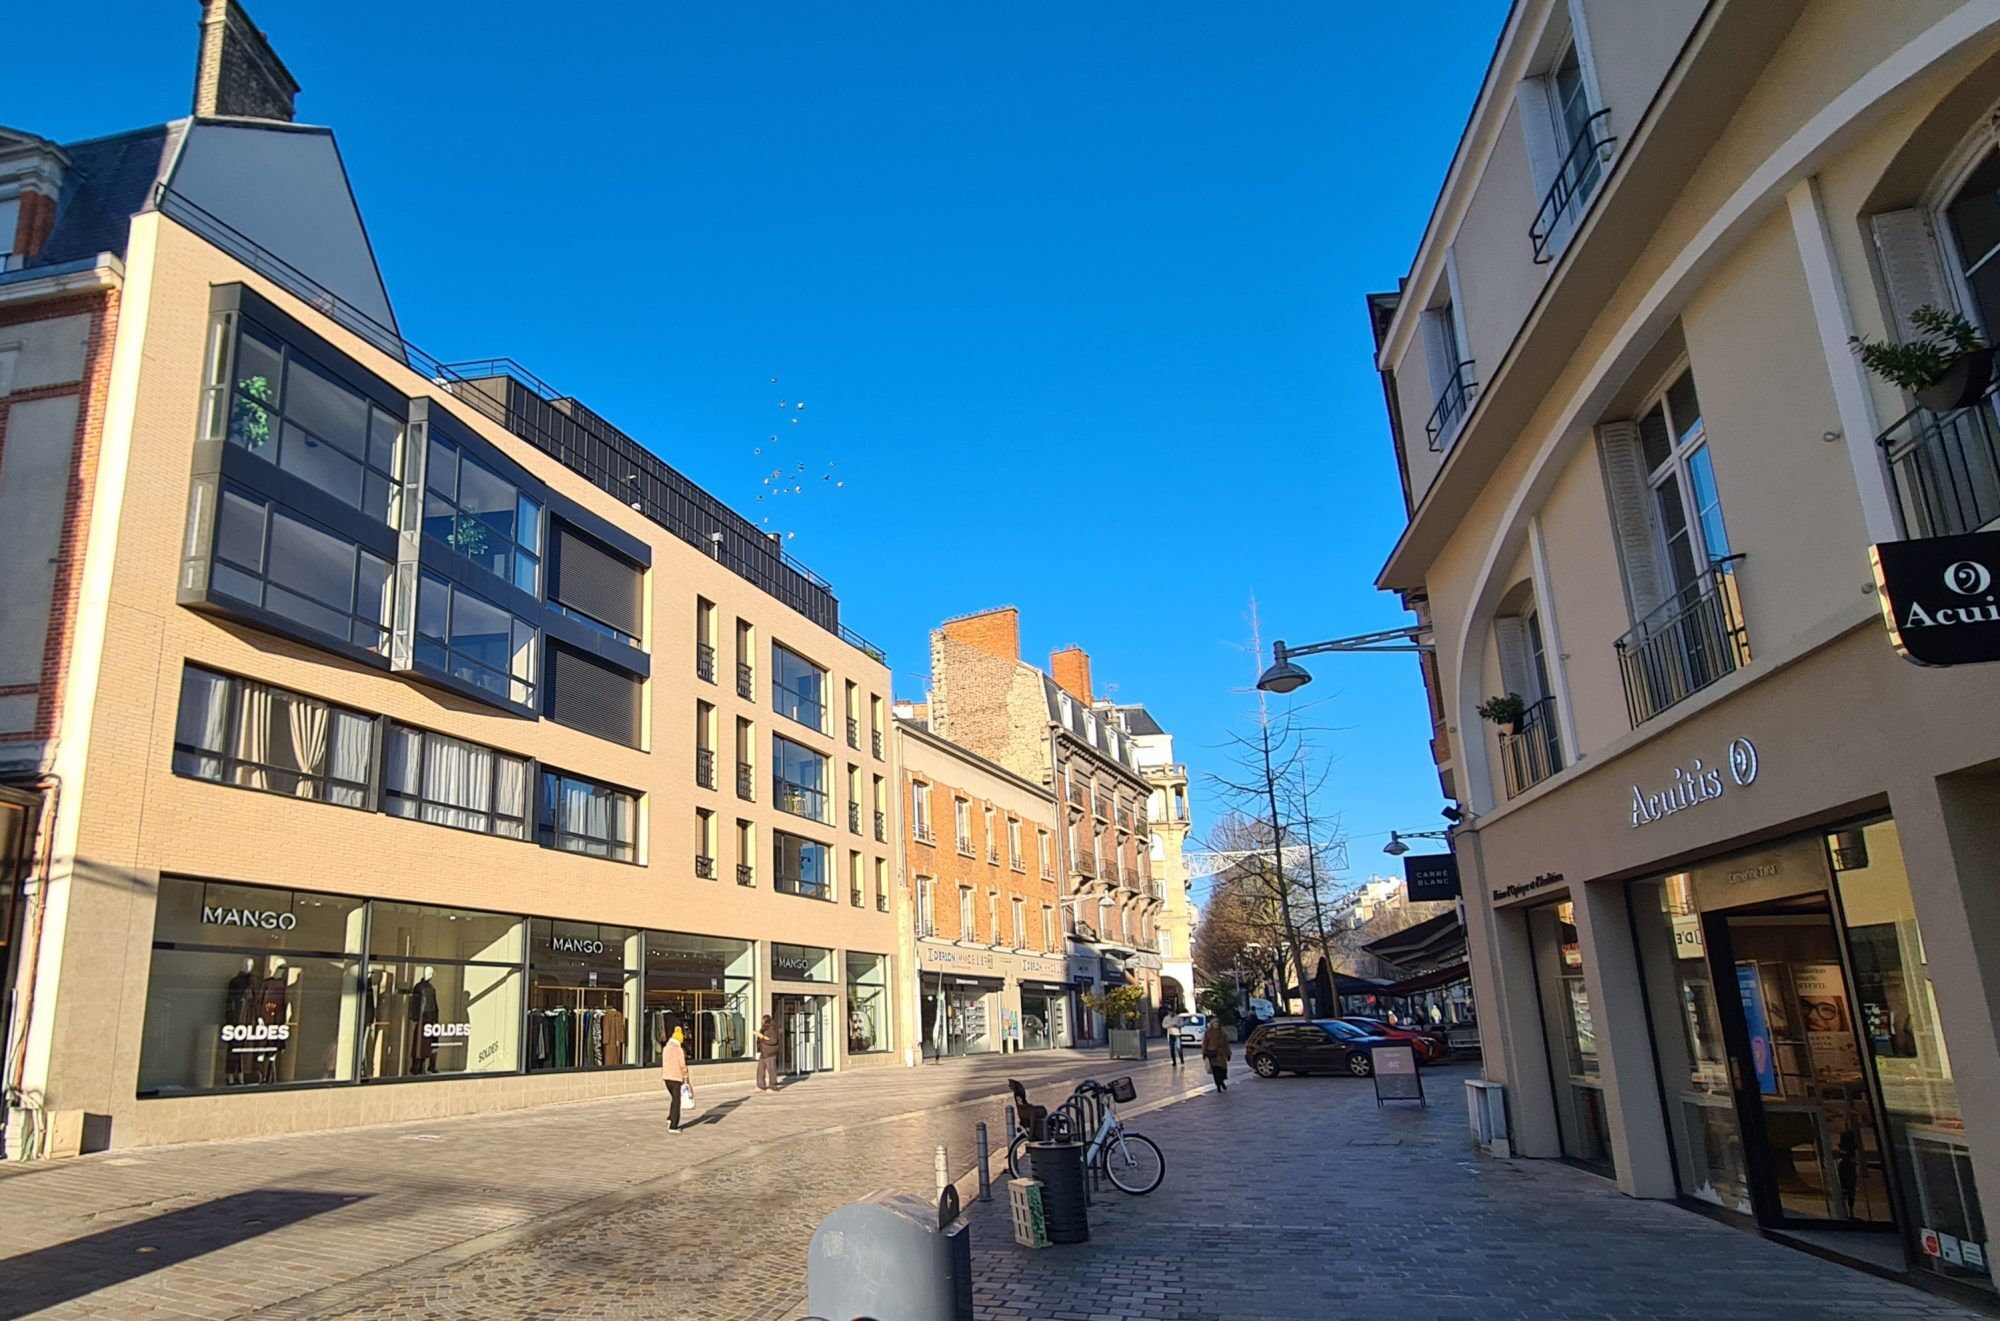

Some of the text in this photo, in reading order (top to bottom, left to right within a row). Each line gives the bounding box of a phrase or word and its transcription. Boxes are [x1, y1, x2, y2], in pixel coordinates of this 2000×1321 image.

[1631, 759, 1725, 828] Acuitis
[1418, 878, 1450, 886] BLANC
[202, 905, 297, 930] MANGO
[553, 937, 604, 954] MANGO
[778, 957, 809, 969] MANGO
[221, 1024, 290, 1041] SOLDES
[423, 1023, 472, 1037] SOLDES
[478, 1041, 499, 1063] SOLDES
